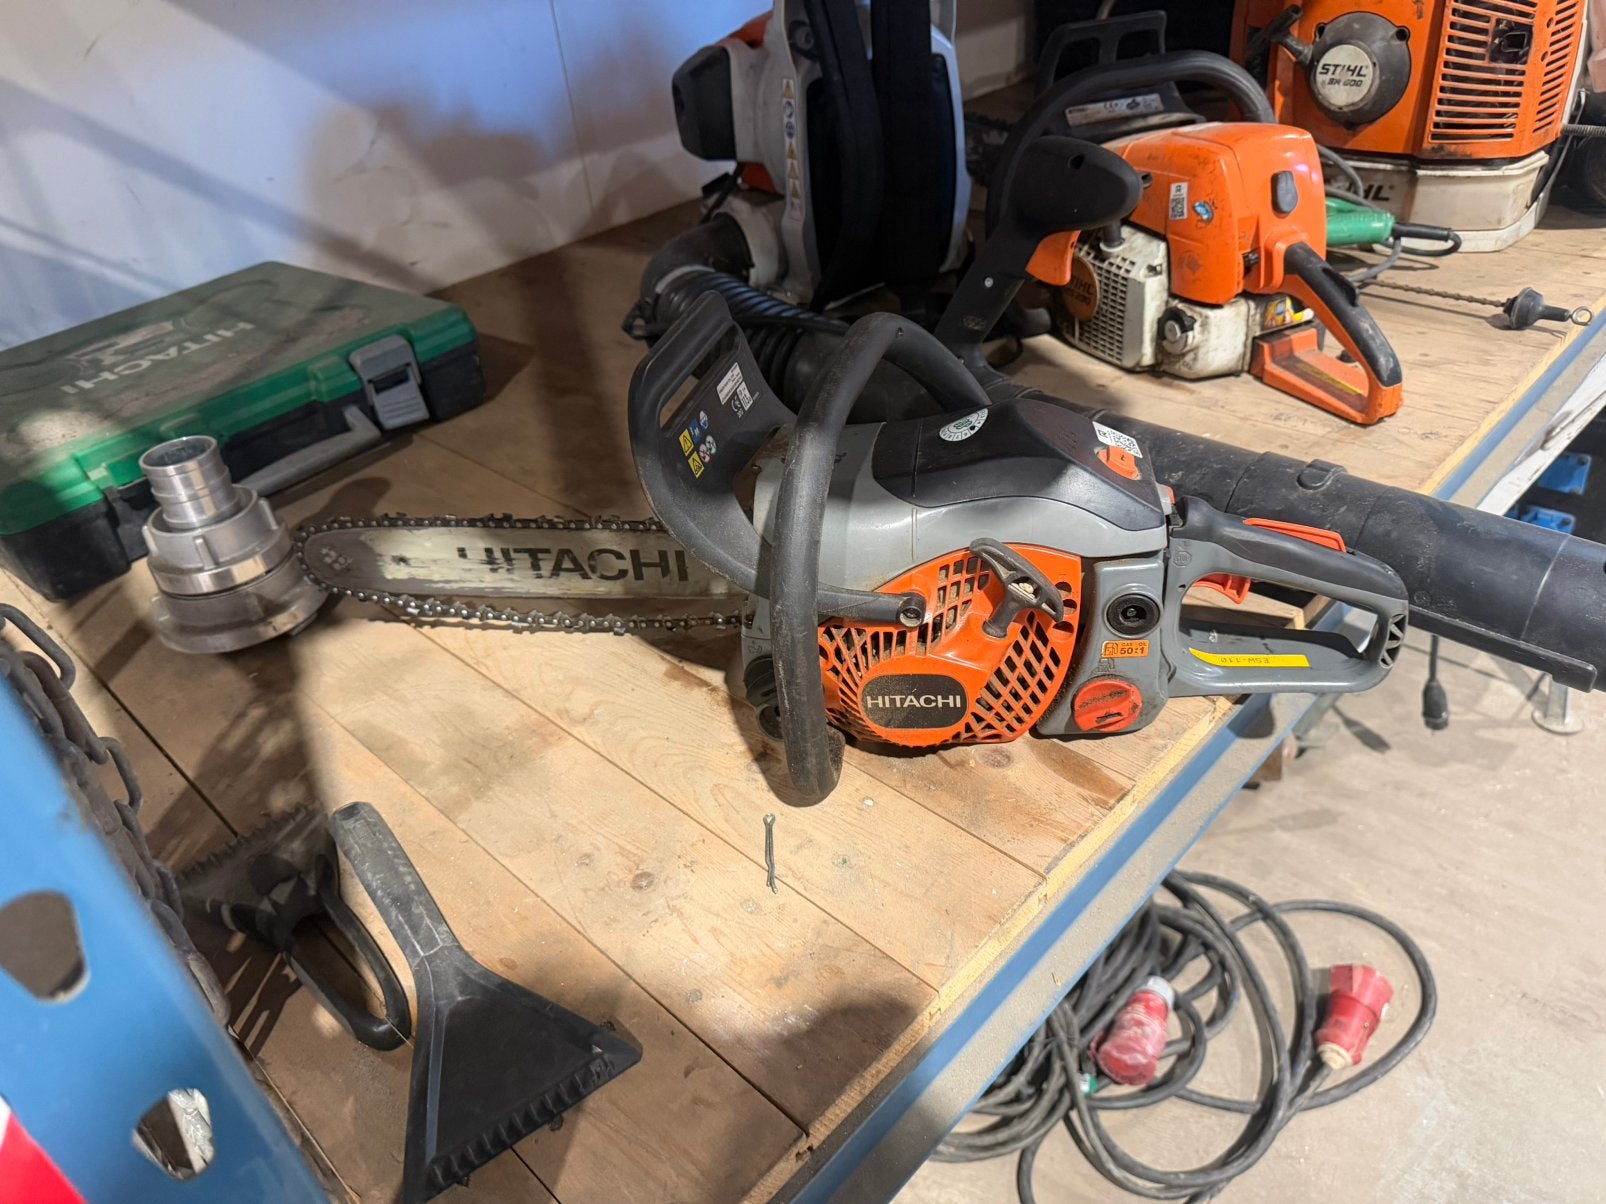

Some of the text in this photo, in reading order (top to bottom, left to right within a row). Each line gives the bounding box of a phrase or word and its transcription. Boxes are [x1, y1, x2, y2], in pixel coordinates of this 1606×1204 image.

[1319, 63, 1367, 77] STIHL
[60, 321, 256, 394] HITACHI
[866, 695, 961, 708] HITACHI
